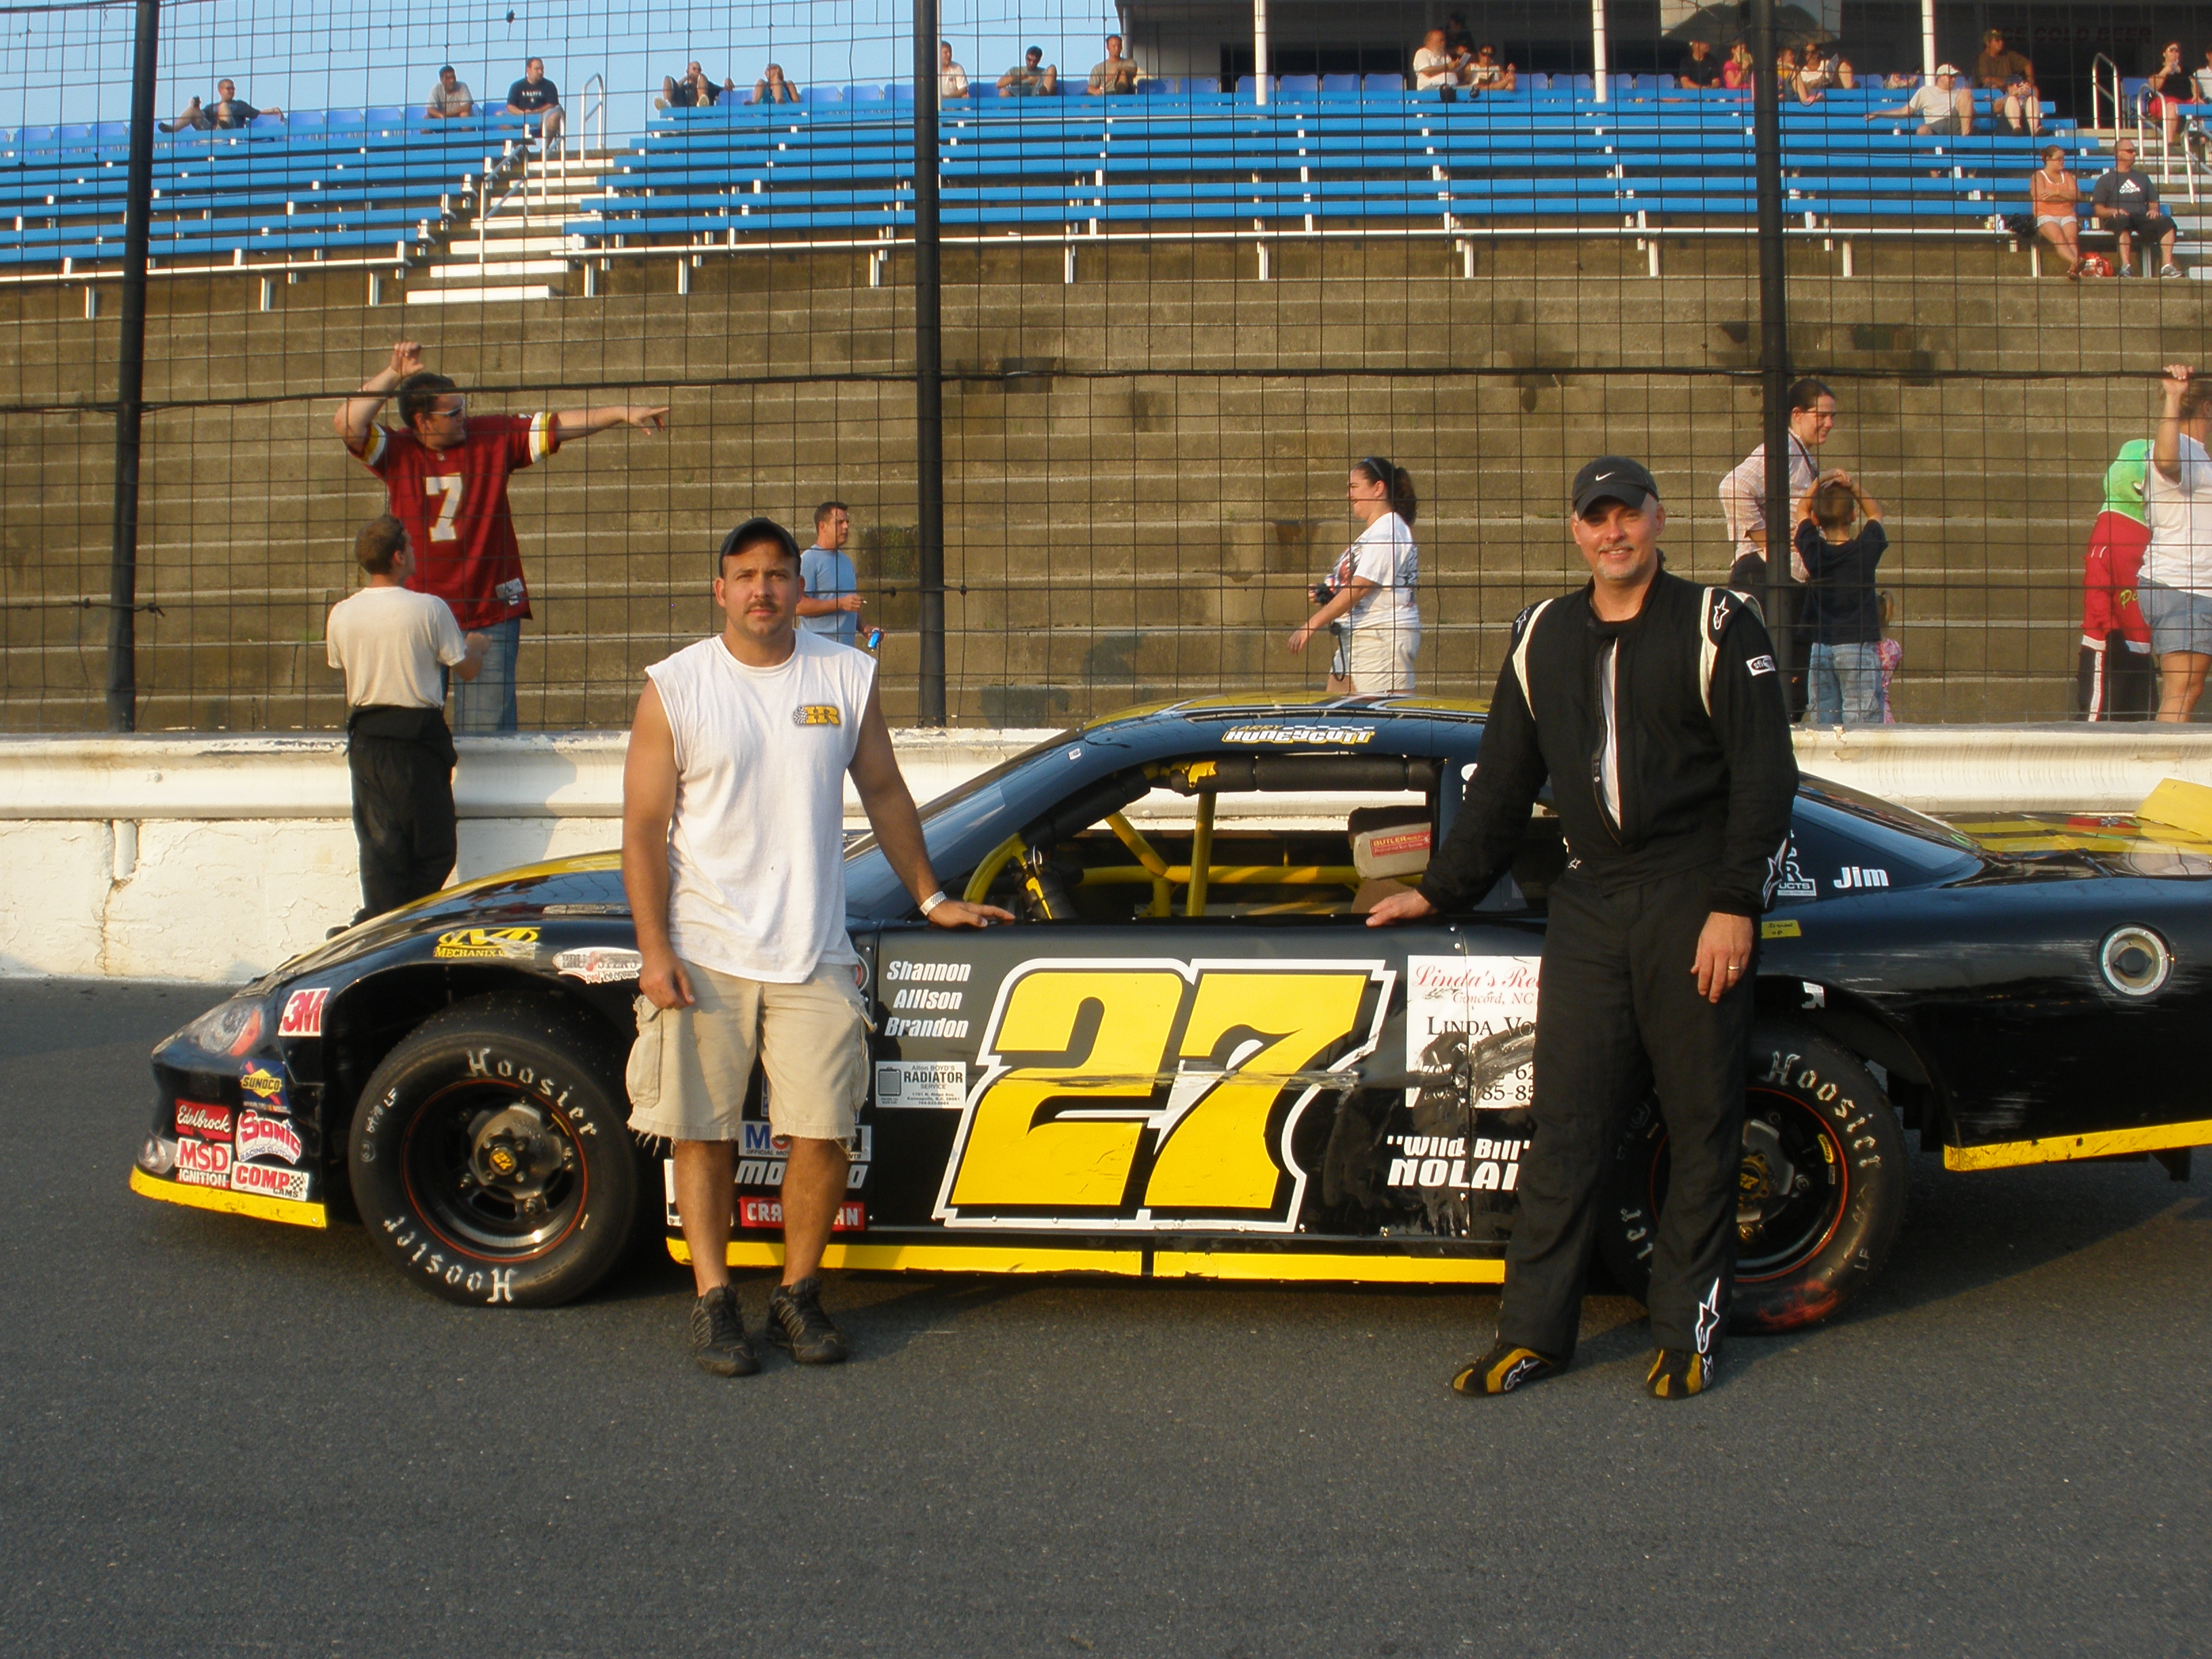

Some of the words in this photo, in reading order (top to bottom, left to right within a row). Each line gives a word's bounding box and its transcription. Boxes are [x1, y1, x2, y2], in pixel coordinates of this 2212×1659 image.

[2096, 27, 2152, 43] BEER
[424, 473, 463, 541] 7
[1373, 836, 1406, 846] BUTLER
[1833, 866, 1889, 888] Jim
[434, 947, 495, 958] MECHANIX
[886, 960, 971, 981] Shannon
[1412, 965, 1495, 987] Linda's
[893, 989, 962, 1010] Allison
[1511, 992, 1534, 1005] NC
[283, 990, 328, 1033] 3M
[884, 1017, 969, 1038] Brandon
[242, 1077, 281, 1090] SUNOCO
[903, 1071, 963, 1084] RADIATOR
[466, 1047, 596, 1136] Hoosier
[937, 962, 1387, 1228] 27
[177, 1105, 230, 1132] Edelbrock
[180, 1140, 228, 1172] MSD
[179, 1168, 226, 1187] IGNITION
[234, 1165, 290, 1189] COMP
[272, 1188, 300, 1197] CAMS
